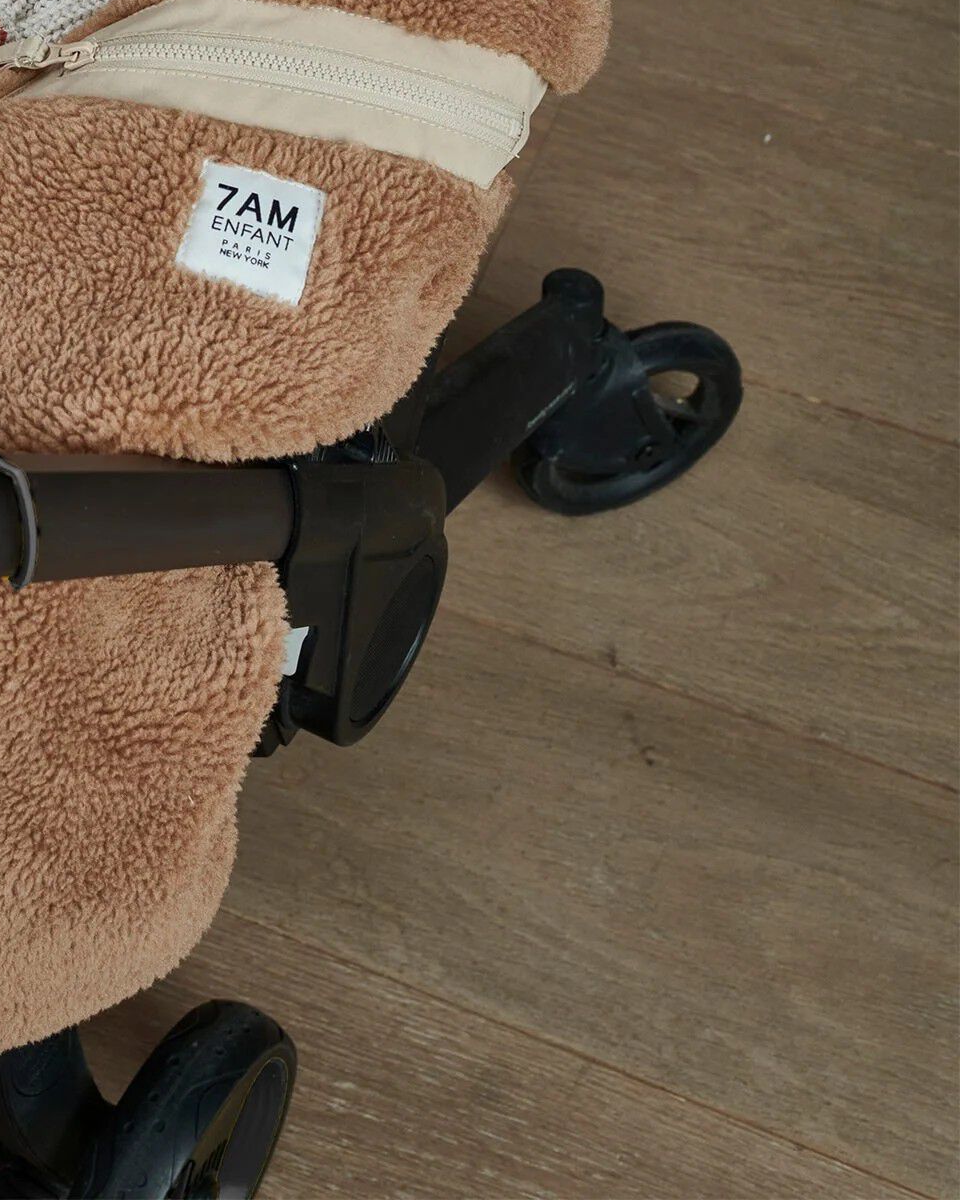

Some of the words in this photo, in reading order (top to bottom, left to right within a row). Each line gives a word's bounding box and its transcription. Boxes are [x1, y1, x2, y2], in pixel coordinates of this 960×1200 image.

[217, 183, 299, 233] 7AM
[212, 216, 294, 251] ENFANT
[220, 248, 242, 260] NEW
[245, 255, 269, 269] YORK
